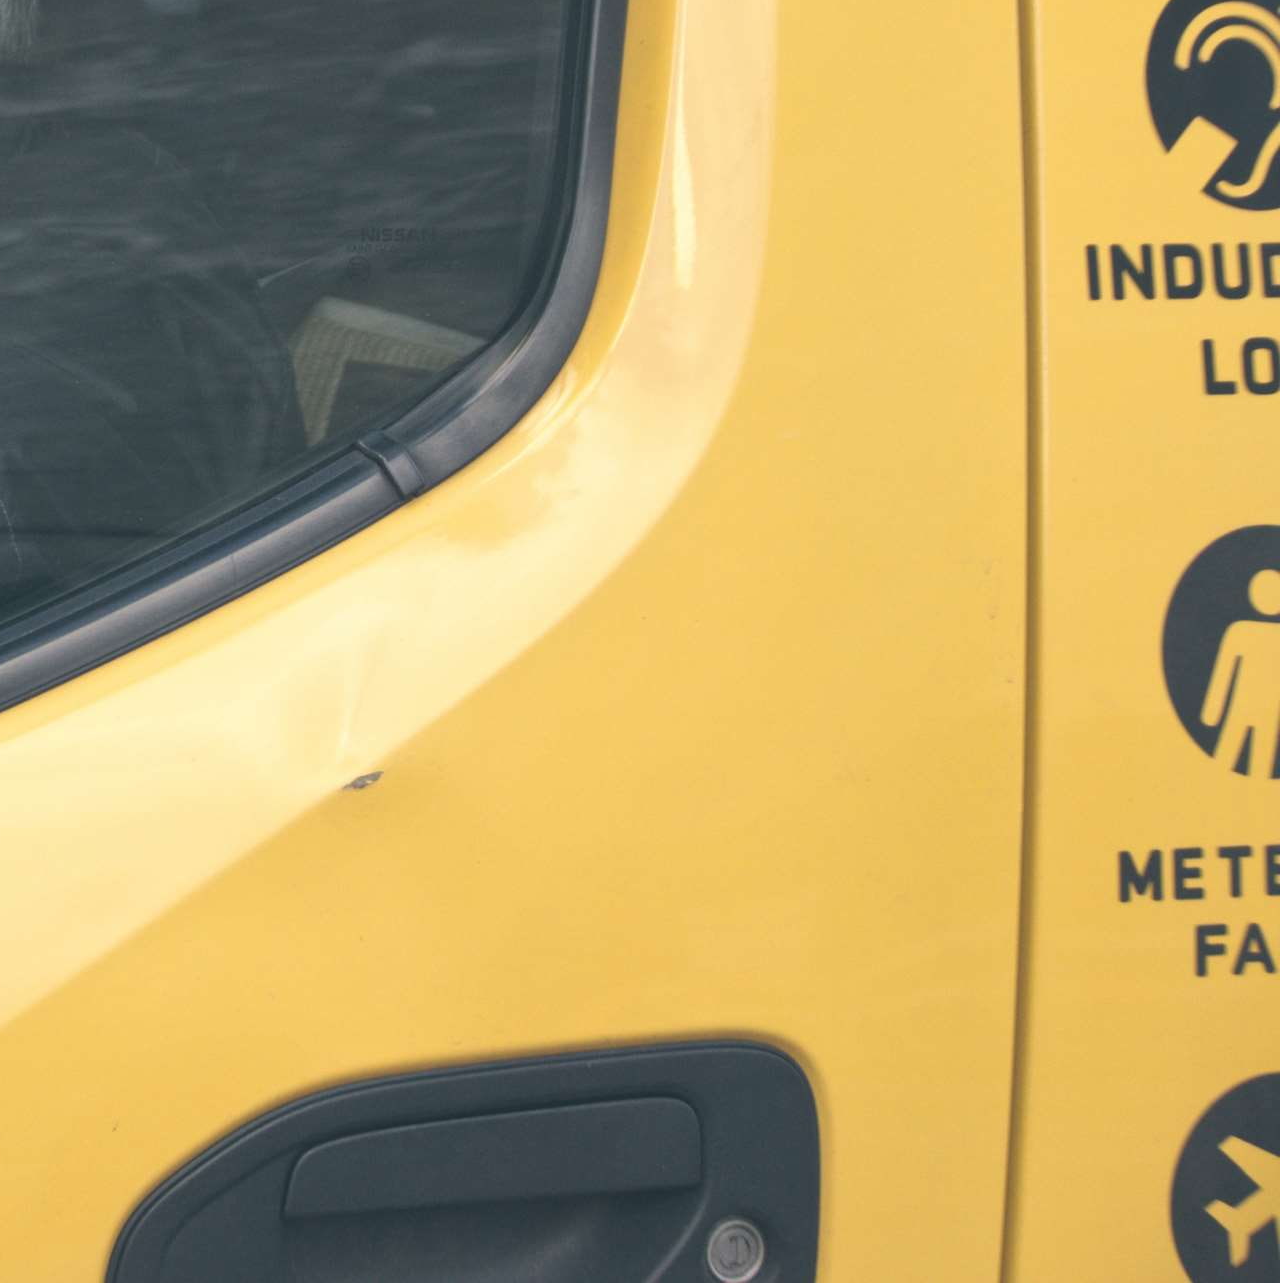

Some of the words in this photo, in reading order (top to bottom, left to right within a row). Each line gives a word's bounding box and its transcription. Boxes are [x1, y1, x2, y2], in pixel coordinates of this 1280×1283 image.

[361, 227, 437, 243] NISSAN
[1202, 336, 1280, 396] LO
[1195, 922, 1277, 978] FA
